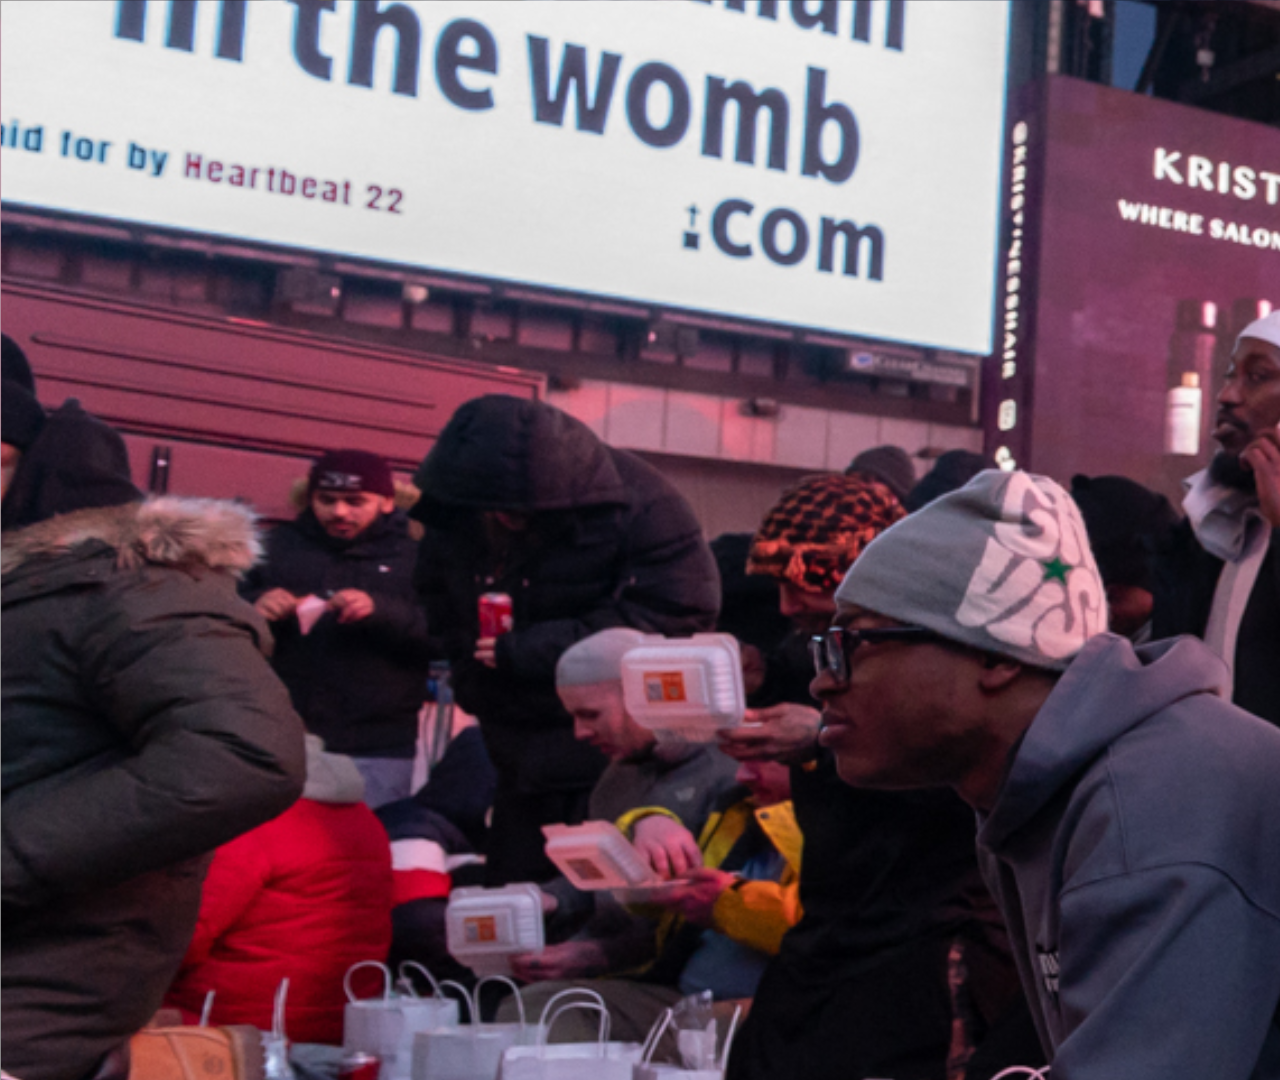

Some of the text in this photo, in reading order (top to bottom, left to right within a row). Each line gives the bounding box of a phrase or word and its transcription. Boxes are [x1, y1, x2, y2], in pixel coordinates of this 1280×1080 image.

[291, 0, 500, 111] the
[526, 32, 860, 183] womb
[60, 129, 112, 164] for
[127, 140, 169, 177] by
[183, 151, 352, 206] Heartbeat
[365, 183, 404, 214] 22
[1117, 199, 1204, 235] WHERE
